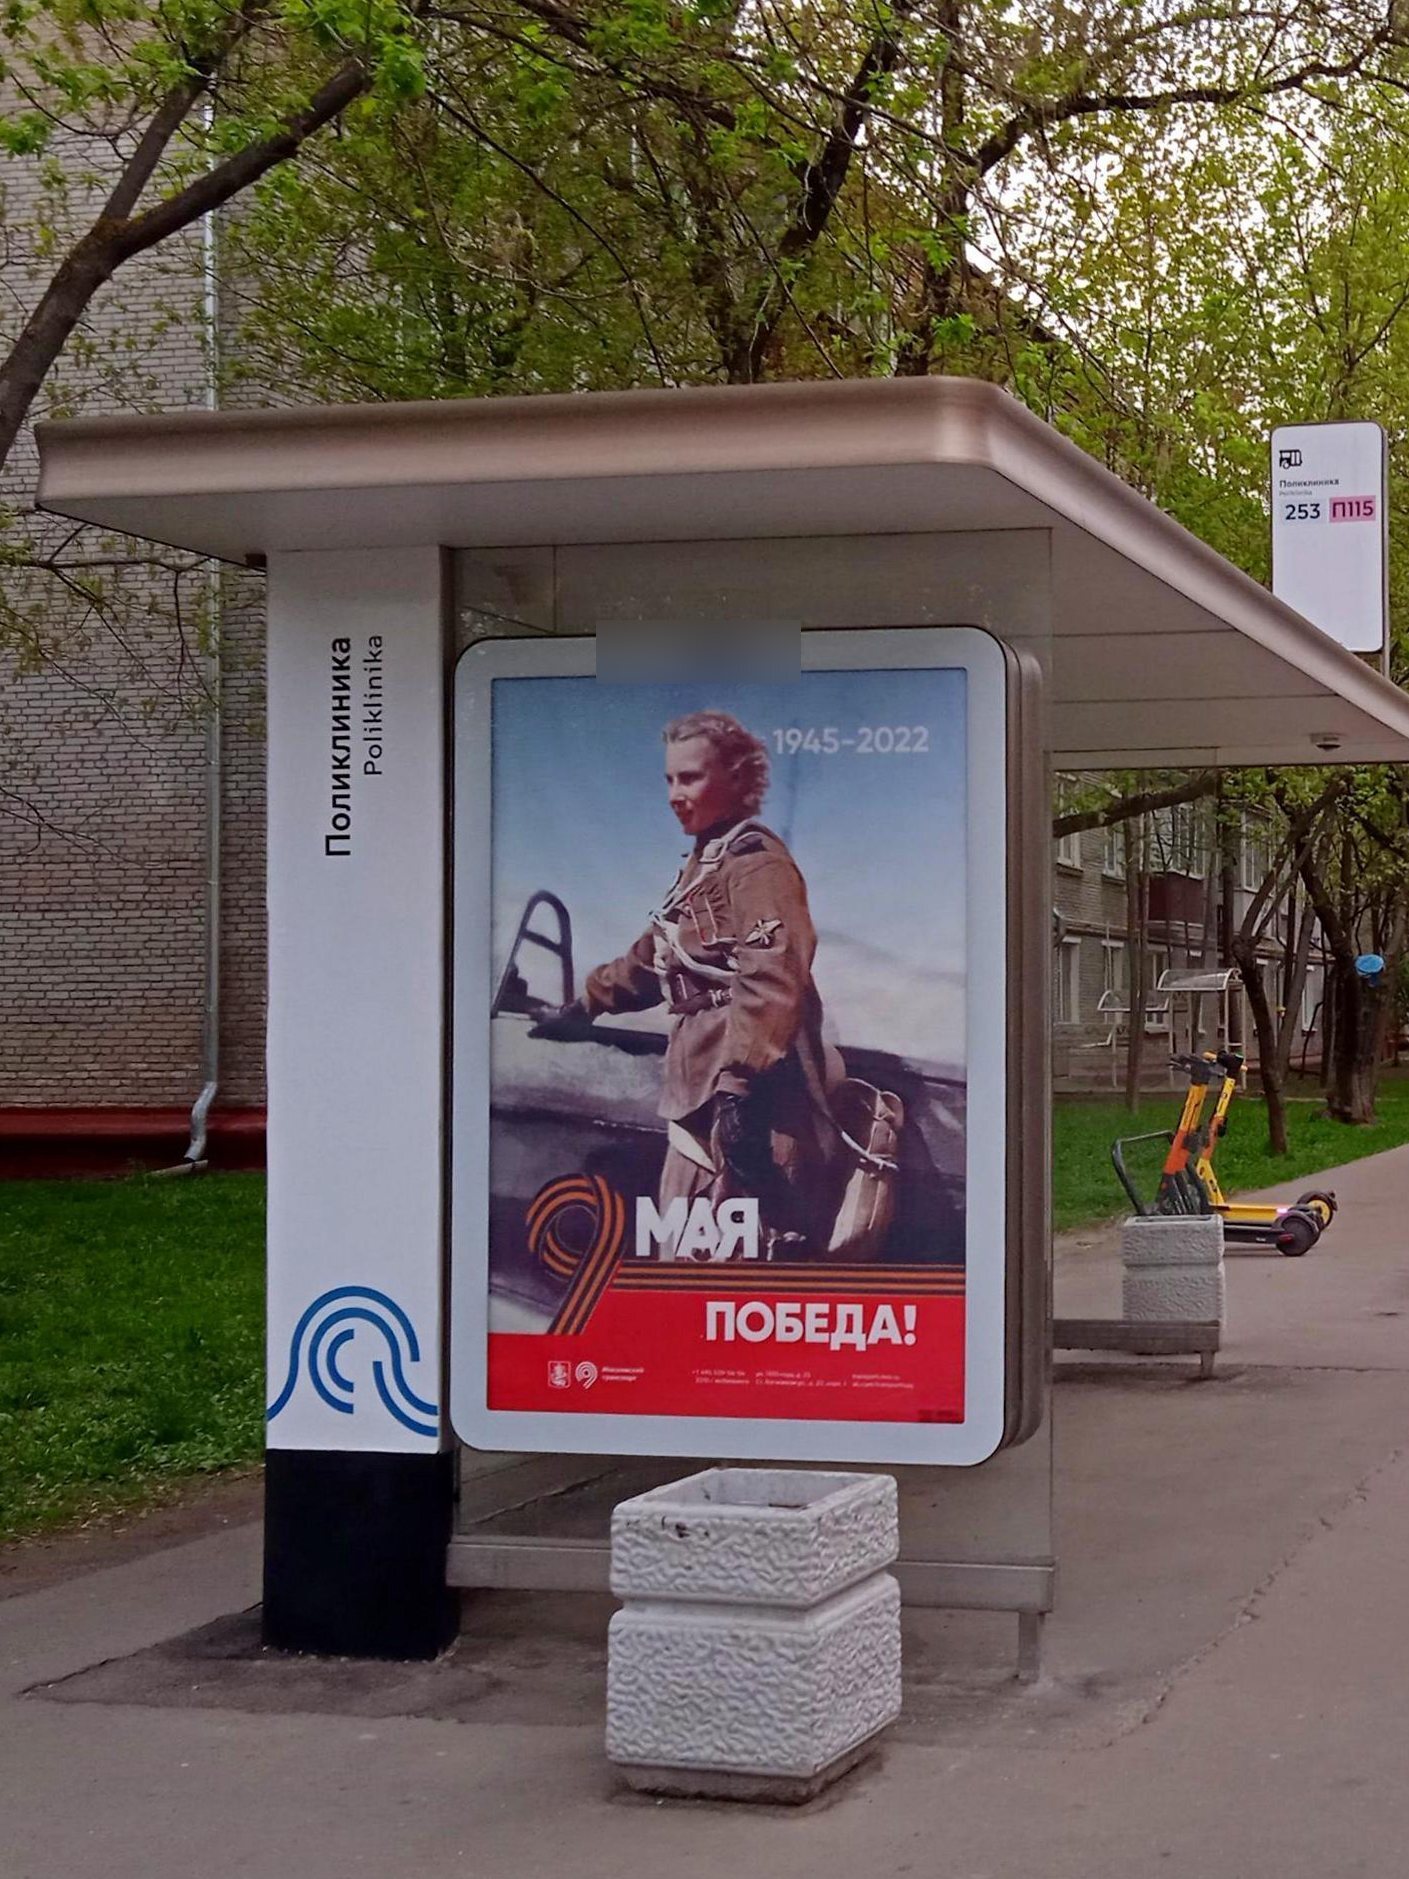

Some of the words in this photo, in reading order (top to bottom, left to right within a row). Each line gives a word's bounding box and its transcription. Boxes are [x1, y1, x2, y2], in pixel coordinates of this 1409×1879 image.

[1285, 503, 1321, 521] 253
[1331, 500, 1374, 519] П115
[363, 635, 383, 775] Poliklinika
[324, 637, 351, 856] Поликлиника
[773, 725, 929, 755] 1945-2022
[635, 1196, 759, 1259] МАЯ
[705, 1301, 917, 1352] ПОБЕДА!
